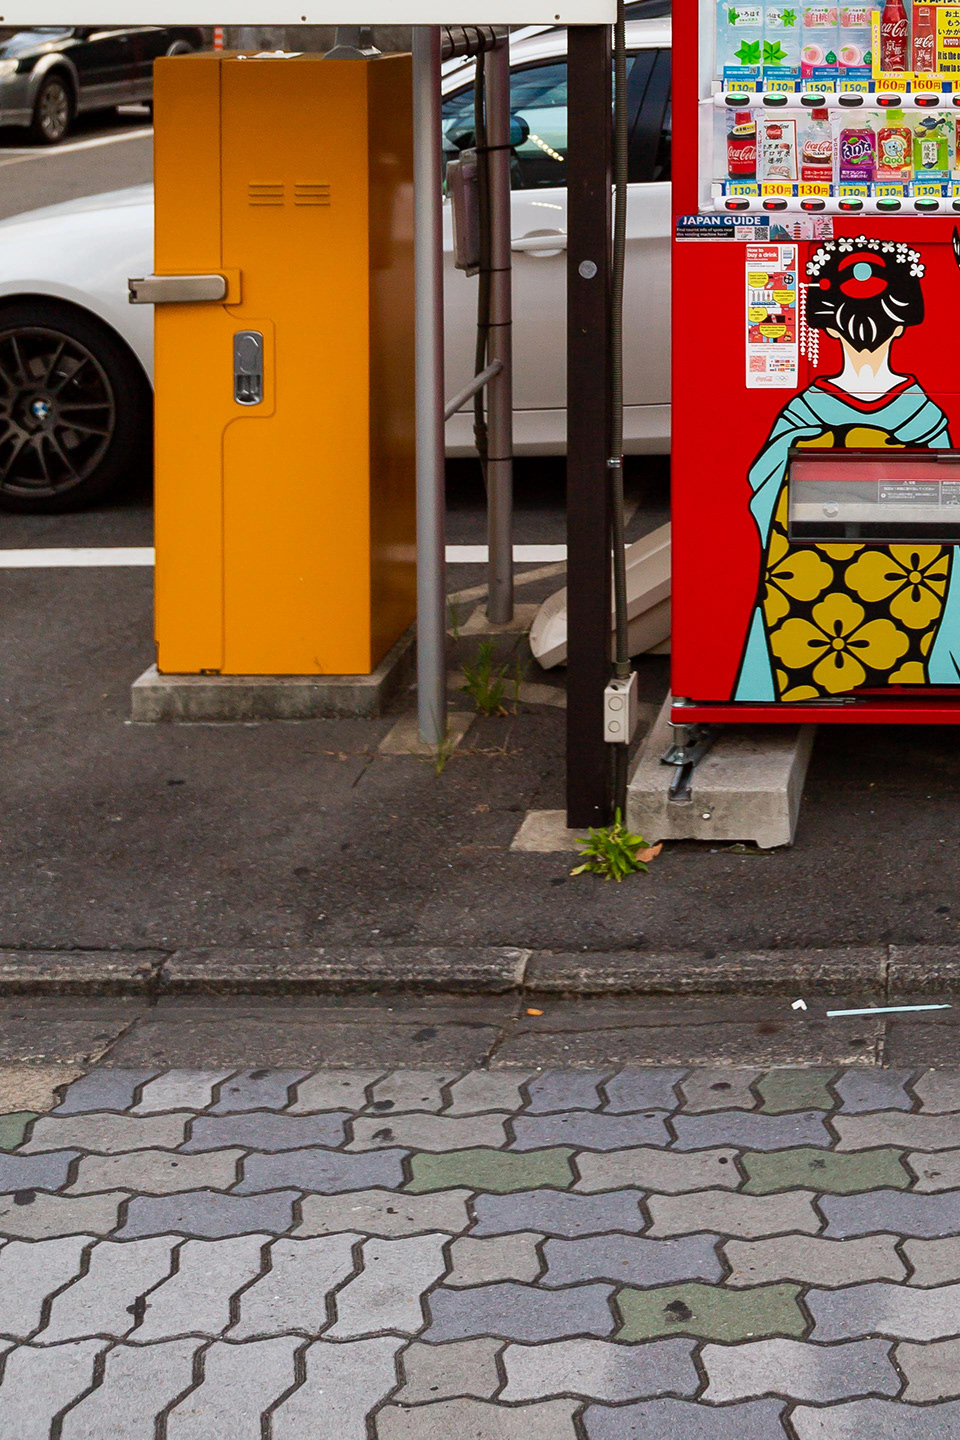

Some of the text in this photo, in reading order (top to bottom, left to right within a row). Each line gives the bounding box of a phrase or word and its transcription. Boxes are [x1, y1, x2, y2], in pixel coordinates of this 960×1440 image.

[947, 52, 956, 60] the
[810, 84, 832, 92] 150円
[877, 80, 906, 90] 160円
[912, 80, 941, 90] 160円
[763, 185, 792, 194] 130円
[800, 185, 829, 194] 130円
[879, 187, 902, 196] 130円
[917, 187, 940, 195] 130円
[683, 216, 761, 225] JAPAN GUIDE
